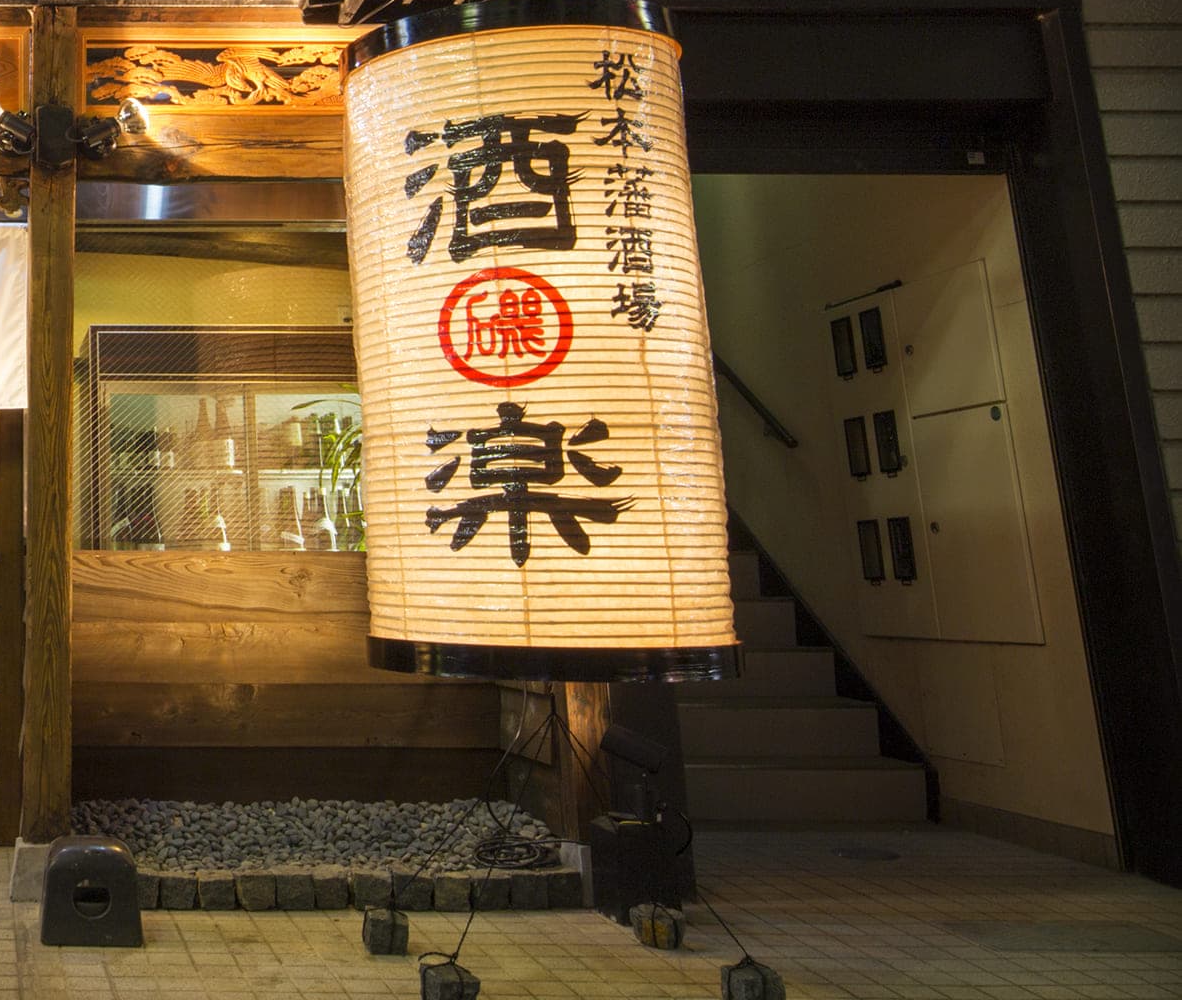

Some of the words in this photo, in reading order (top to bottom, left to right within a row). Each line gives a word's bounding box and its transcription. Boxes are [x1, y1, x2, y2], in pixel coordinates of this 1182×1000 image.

[586, 50, 663, 334] 松本藩酒場
